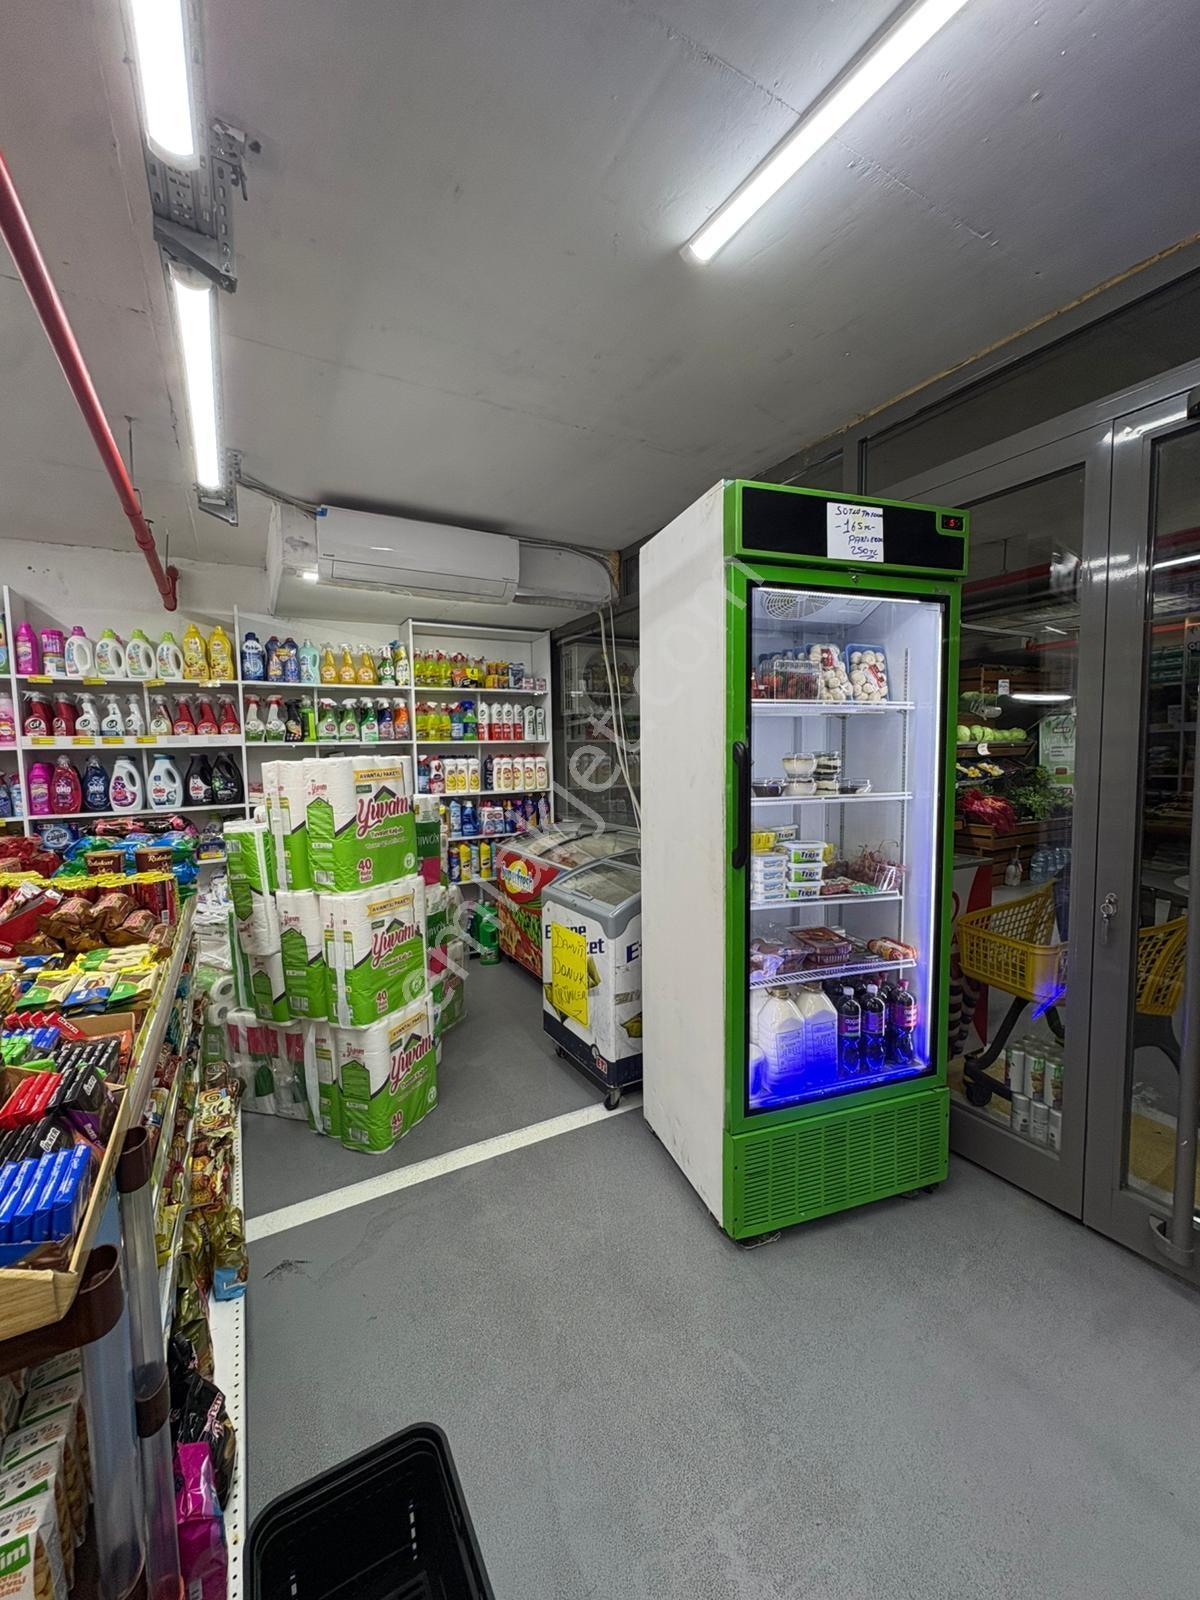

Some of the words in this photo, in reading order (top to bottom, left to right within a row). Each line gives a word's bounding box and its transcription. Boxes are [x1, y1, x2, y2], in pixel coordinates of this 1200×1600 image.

[357, 796, 409, 839] Yuvam
[358, 857, 372, 870] 40
[372, 924, 415, 968] Yuvam
[376, 990, 387, 1001] 40
[390, 1034, 433, 1094] Yuvam
[391, 1109, 403, 1125] 40
[39, 1126, 61, 1152] ÜLKER
